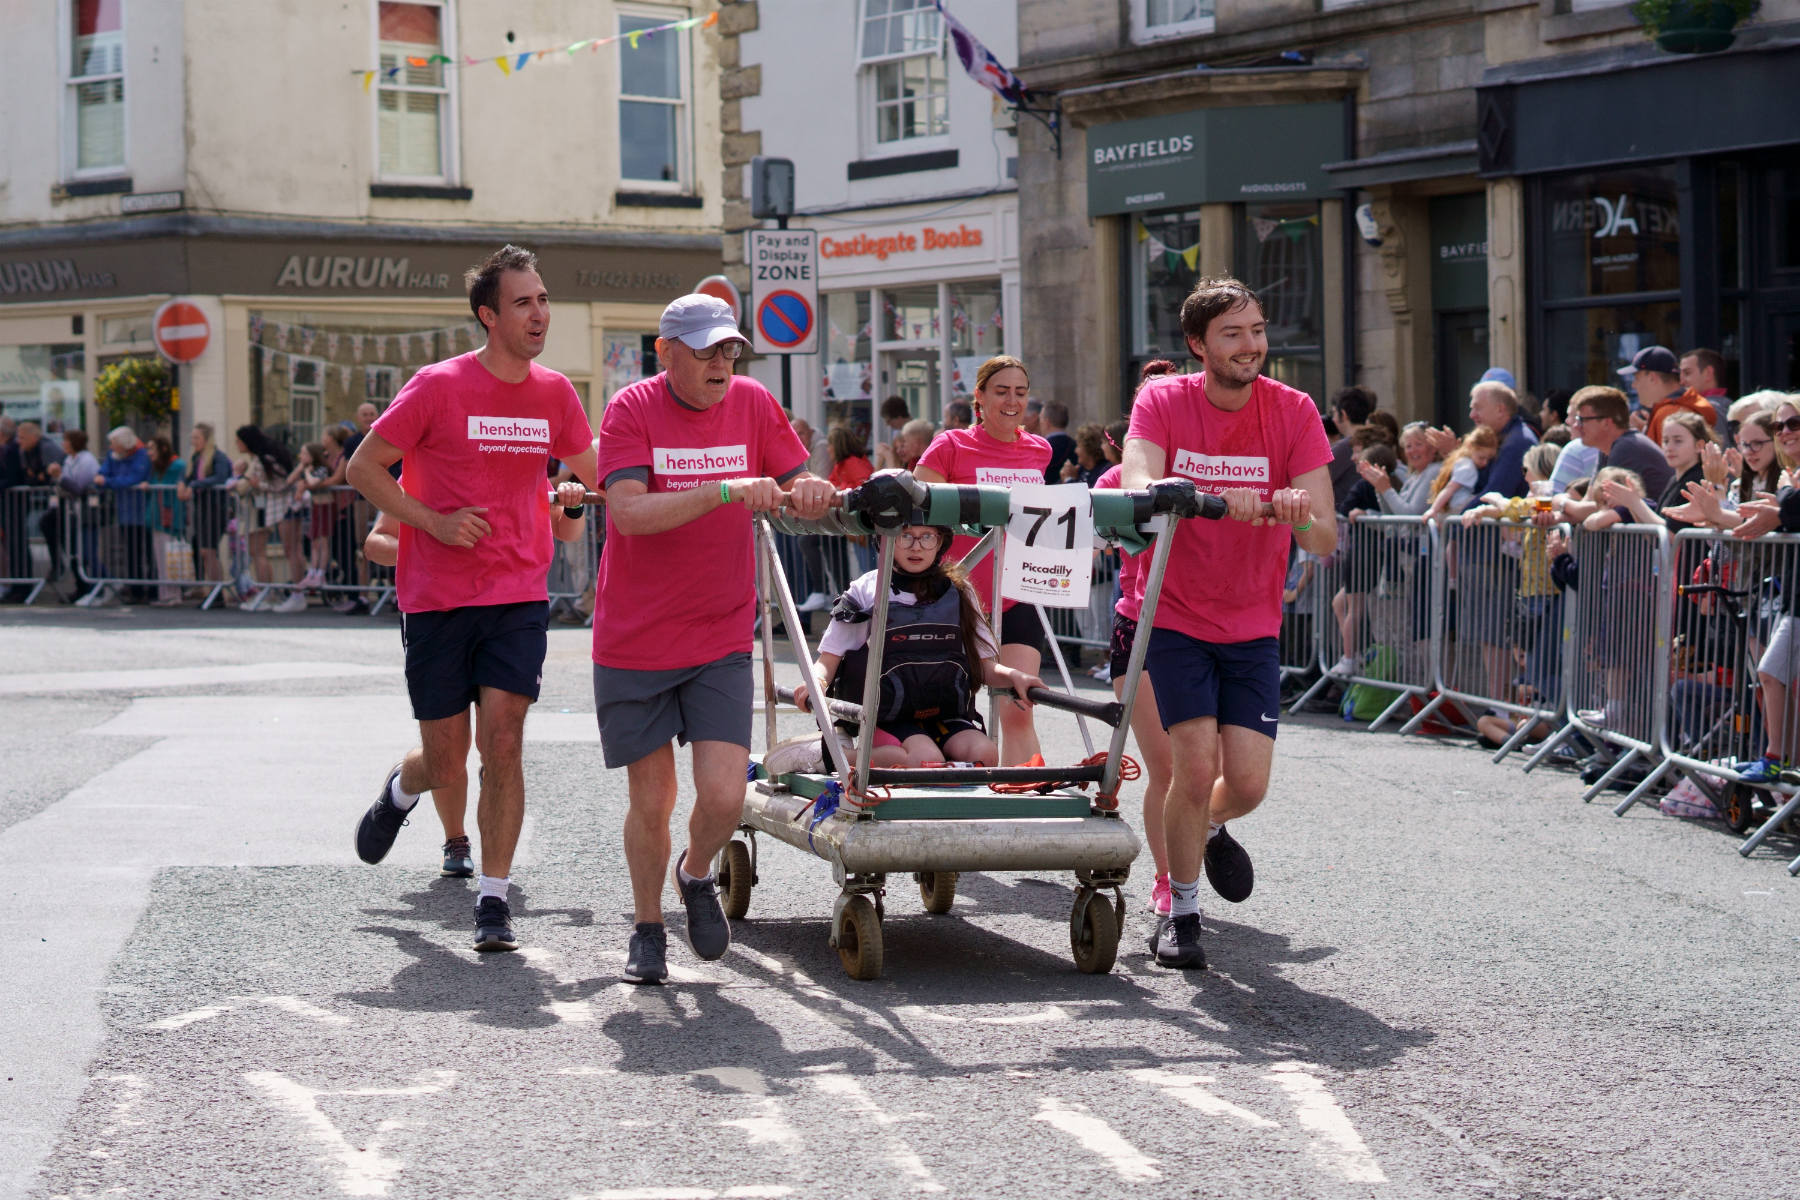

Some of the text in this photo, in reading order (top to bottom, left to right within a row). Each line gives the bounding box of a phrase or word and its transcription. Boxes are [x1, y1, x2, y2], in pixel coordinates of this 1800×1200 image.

[1094, 134, 1194, 165] BAYFIELDS
[757, 235, 810, 248] Pay and
[820, 224, 983, 261] Castlegate Books
[759, 249, 808, 263] Display
[276, 255, 450, 289] AURUM HAIR
[757, 265, 811, 281] ZONE
[478, 443, 507, 455] beyond
[666, 478, 699, 491] beyond
[1022, 505, 1077, 550] 71
[1021, 561, 1073, 577] Piccadilly
[908, 633, 956, 641] SOLA
